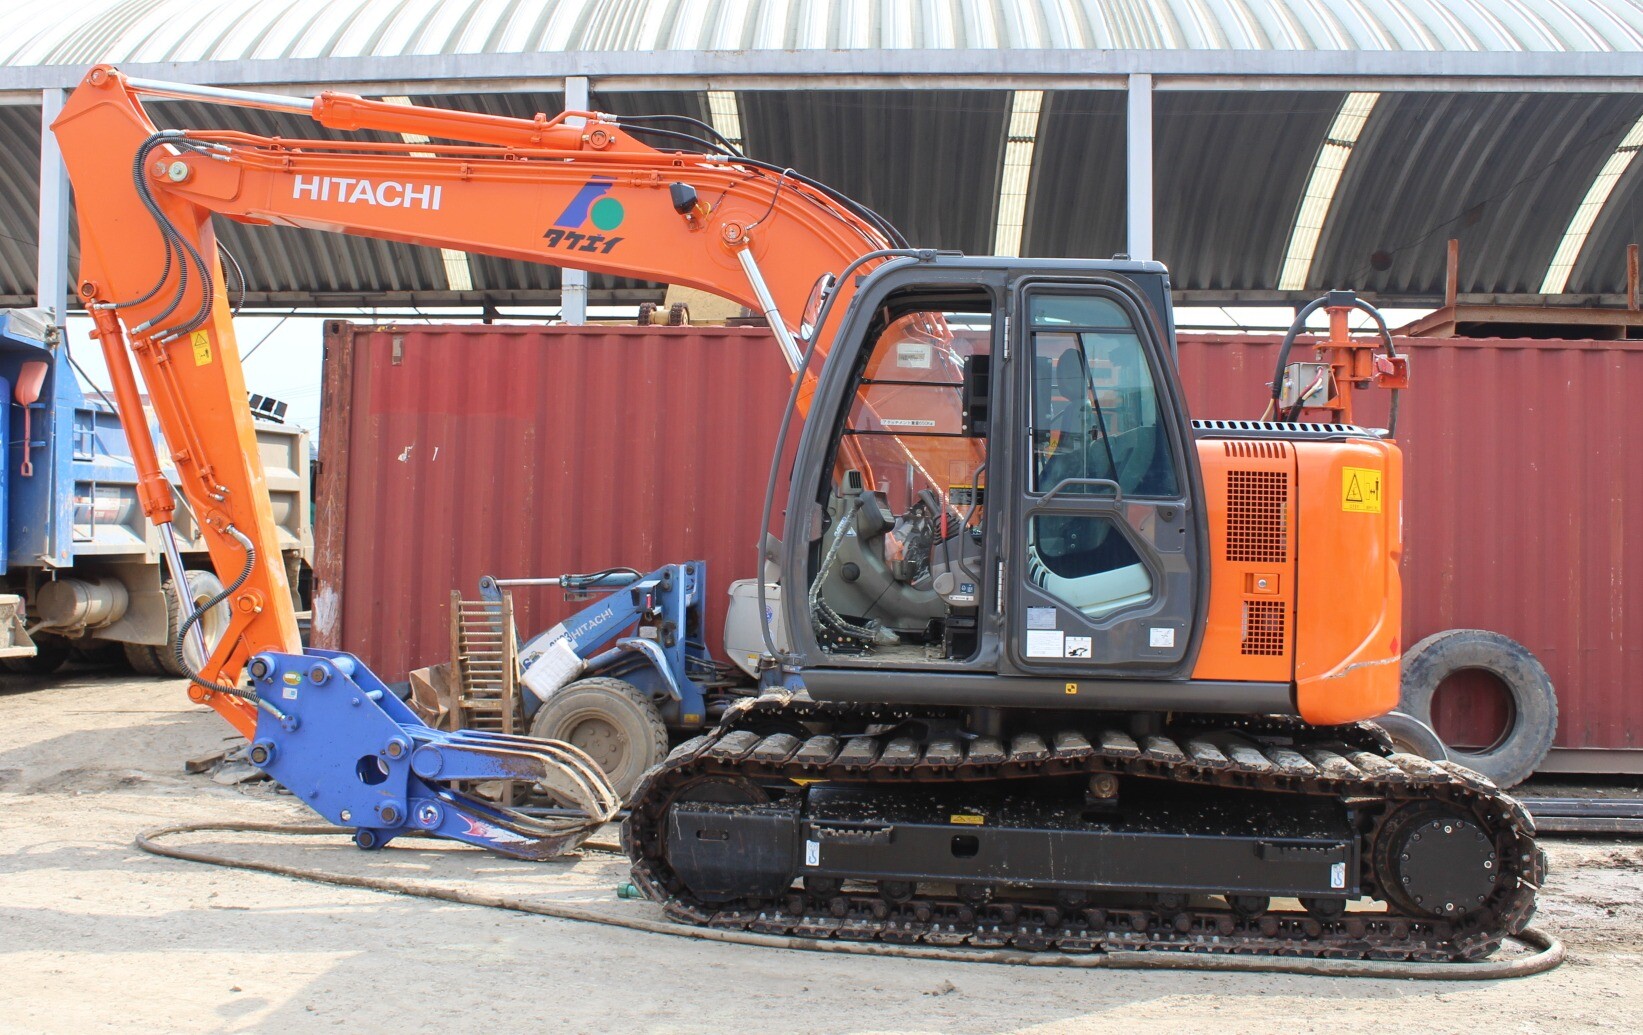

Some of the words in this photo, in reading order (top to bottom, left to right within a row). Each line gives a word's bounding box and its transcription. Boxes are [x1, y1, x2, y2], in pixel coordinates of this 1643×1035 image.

[293, 174, 442, 210] HITACHI
[543, 229, 625, 254] タケエイ
[571, 608, 614, 640] HITACHI
